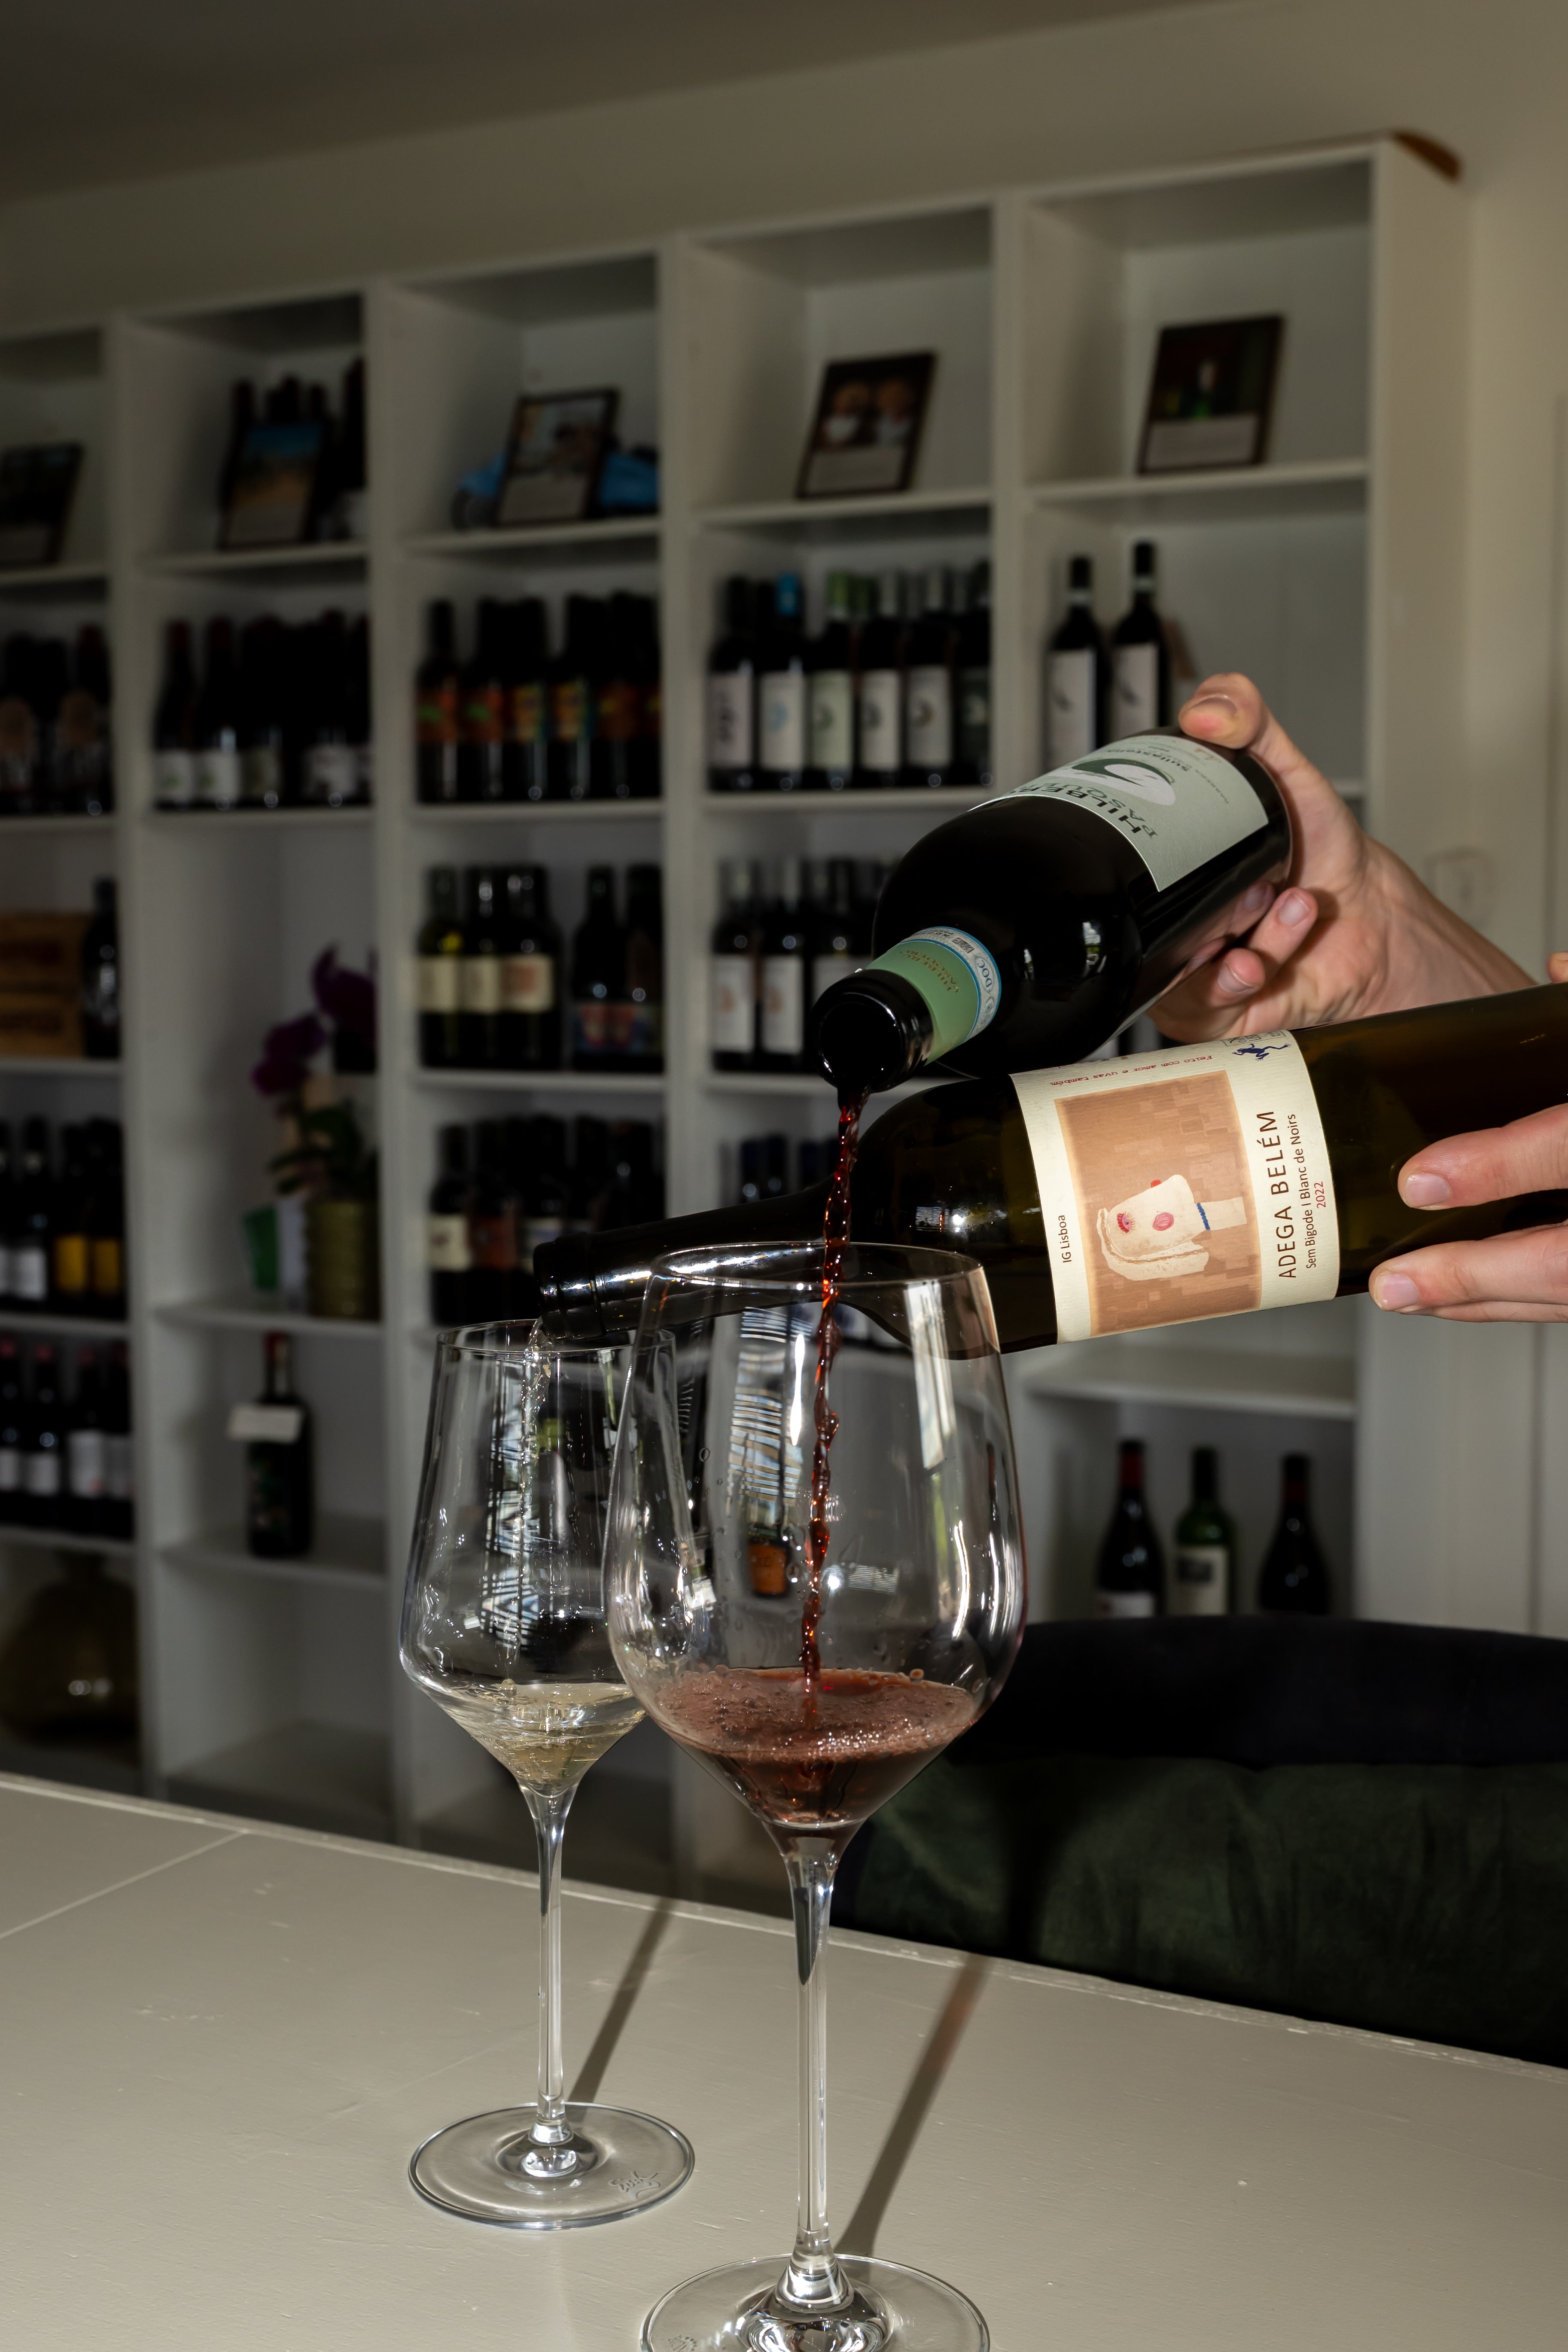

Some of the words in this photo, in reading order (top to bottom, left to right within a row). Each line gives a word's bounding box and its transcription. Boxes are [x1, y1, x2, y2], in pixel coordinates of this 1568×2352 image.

[977, 960, 993, 987] DOC
[1287, 1114, 1301, 1145] Noirs
[1256, 1112, 1289, 1195] BELÉM
[1293, 1148, 1305, 1163] de
[1298, 1166, 1311, 1199] Blanc
[1314, 1181, 1326, 1209] 2022
[1058, 1215, 1070, 1249] Lisboa
[1274, 1206, 1297, 1278] ADEGA
[1302, 1209, 1317, 1246] Bigode
[1062, 1251, 1072, 1263] IG
[1306, 1248, 1316, 1269] Sem
